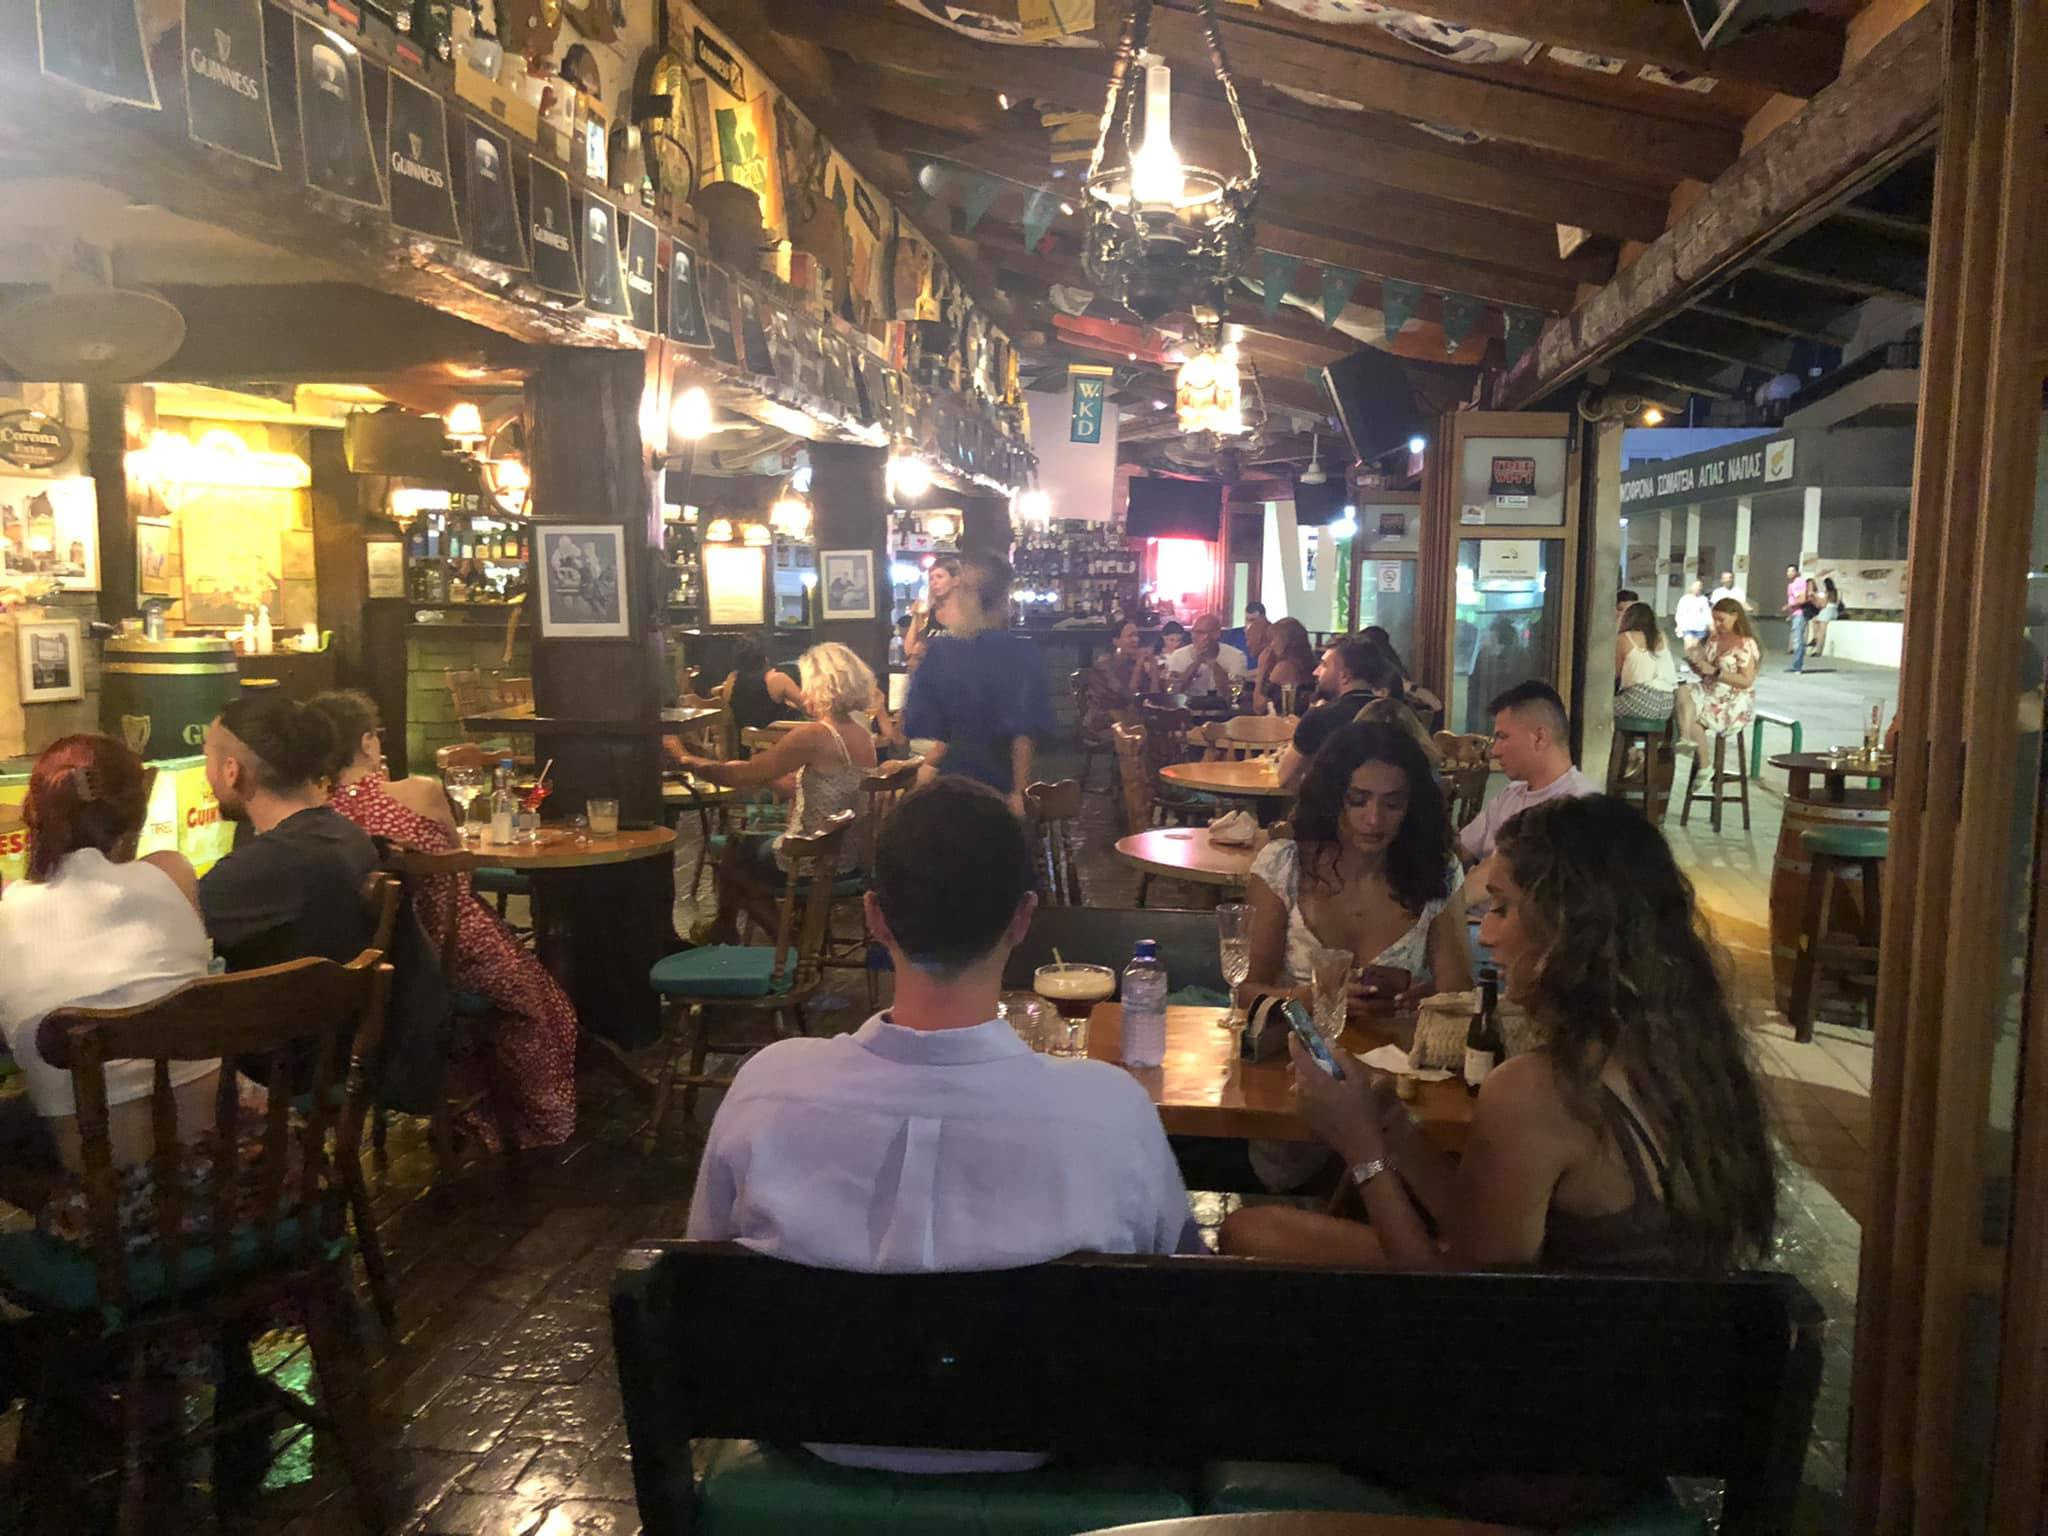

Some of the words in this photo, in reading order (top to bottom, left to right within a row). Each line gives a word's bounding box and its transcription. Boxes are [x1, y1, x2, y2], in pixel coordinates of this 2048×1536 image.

[190, 48, 259, 100] GUINNESS
[391, 151, 444, 188] GUINNESS
[0, 427, 61, 448] Corona
[1698, 461, 1724, 488] ΑΓΙΑΣ
[1727, 452, 1763, 483] ΝΑΠΑΣ
